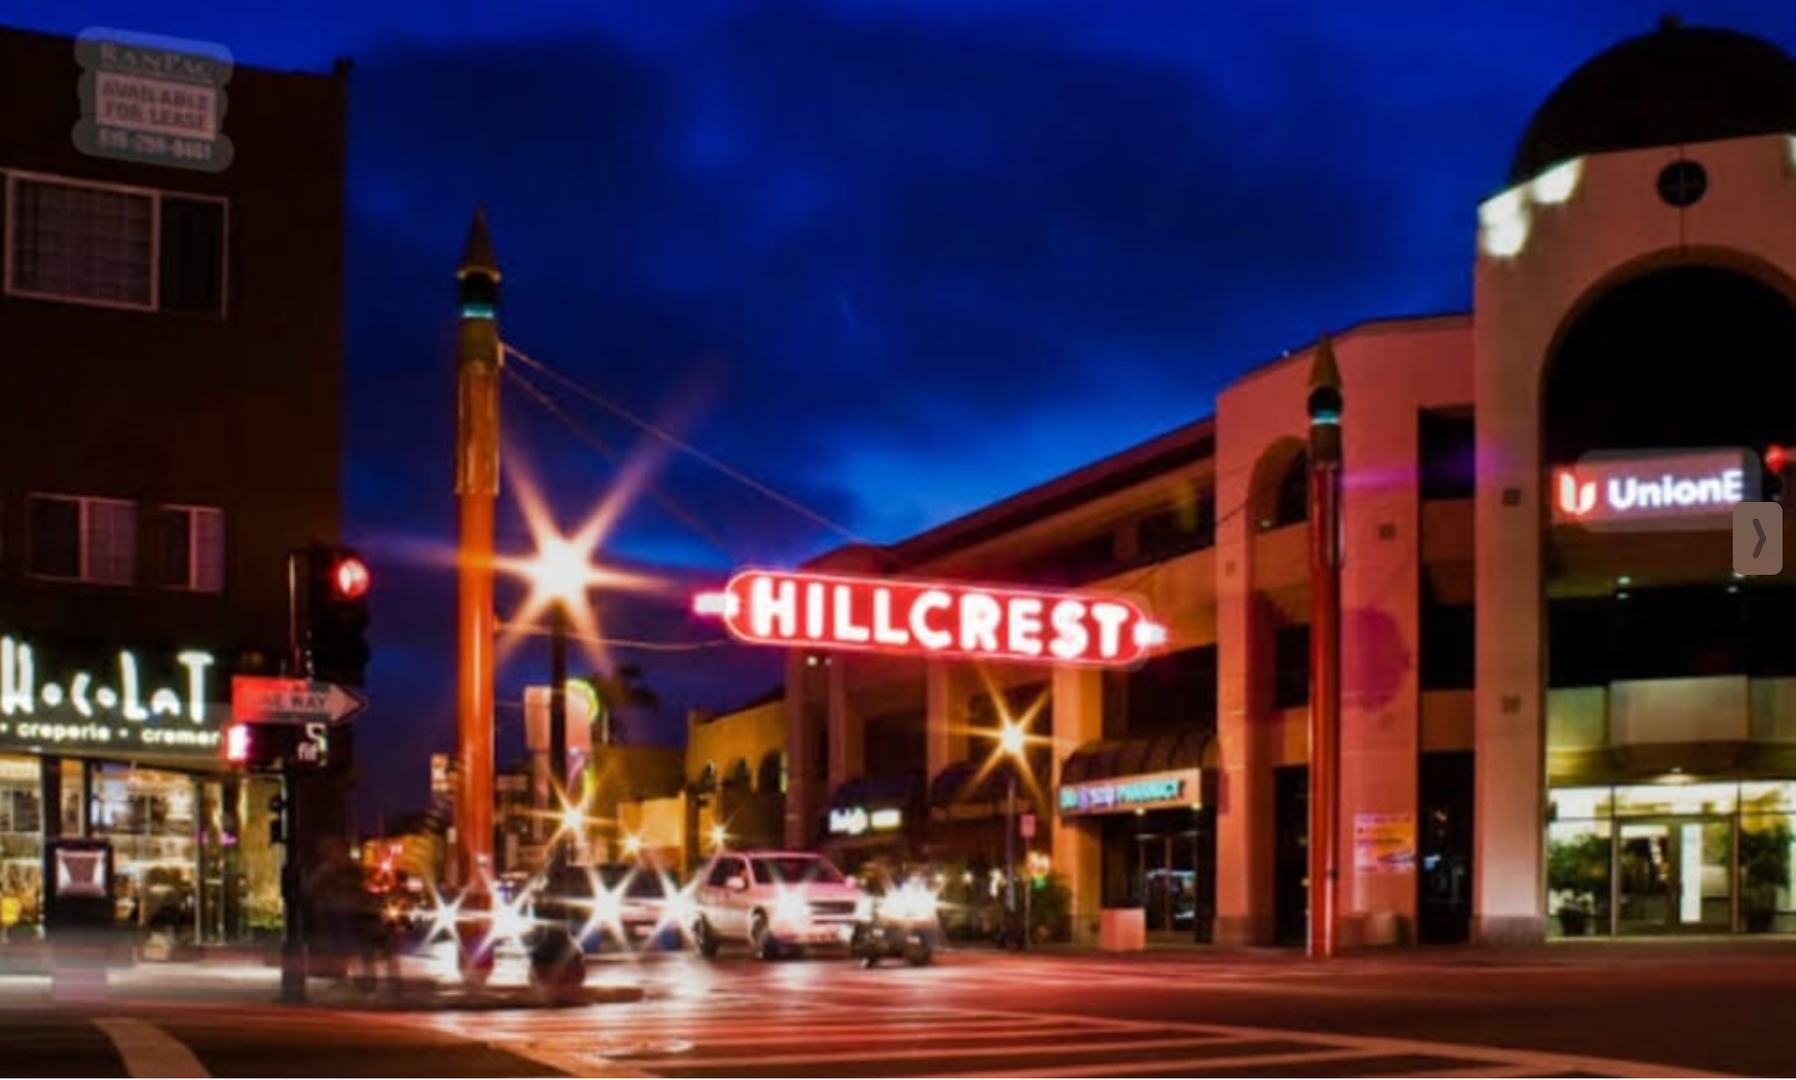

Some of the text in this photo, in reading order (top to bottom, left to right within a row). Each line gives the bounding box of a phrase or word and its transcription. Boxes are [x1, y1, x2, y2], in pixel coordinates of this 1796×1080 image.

[102, 81, 209, 112] AVAILABLE
[105, 99, 206, 131] FOR LEASE
[749, 575, 1130, 659] HILLCREST
